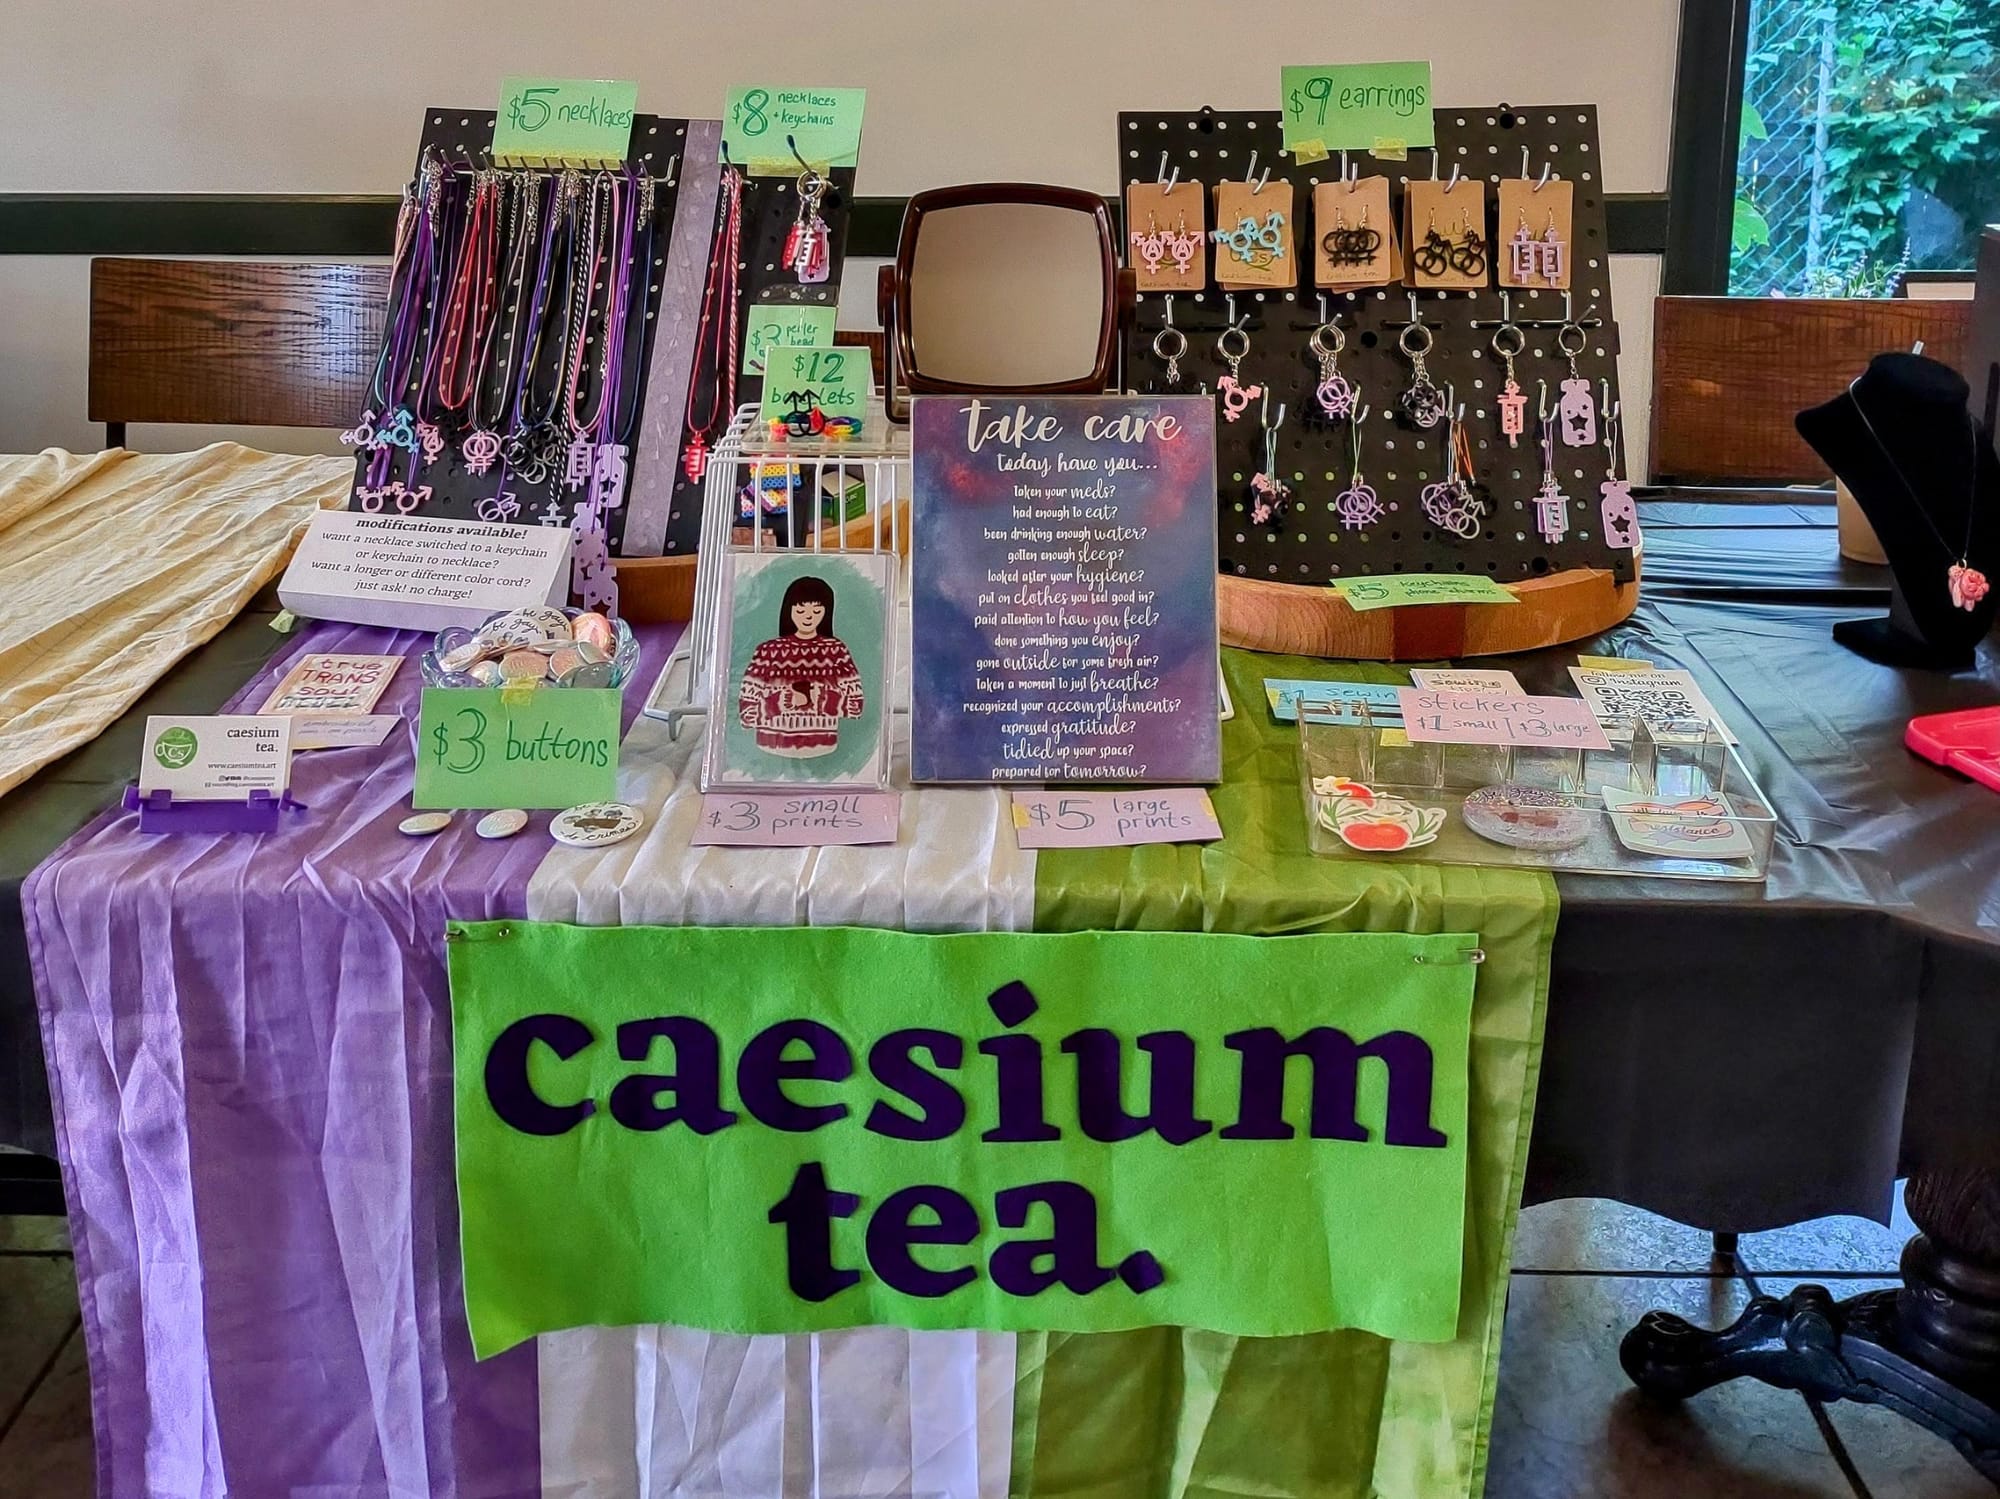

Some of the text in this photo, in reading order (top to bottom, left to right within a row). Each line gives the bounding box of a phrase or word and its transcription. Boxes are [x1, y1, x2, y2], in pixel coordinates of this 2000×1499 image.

[507, 88, 634, 131] $5 necklaces
[1290, 77, 1425, 125] $9 earrings
[731, 89, 836, 137] $8 necklaces
[786, 323, 818, 337] perler
[791, 336, 815, 346] bead
[792, 351, 845, 385] $12
[772, 387, 855, 406] blets
[959, 399, 1182, 452] take care
[997, 453, 1158, 478] today have you...
[1014, 479, 1116, 501] taken your meds?
[1013, 506, 1118, 522] had enough to eat?
[356, 518, 528, 540] modifications available!
[984, 527, 1147, 542] been drinking enough water?
[322, 531, 351, 542] want
[364, 534, 413, 548] necklace
[416, 538, 468, 553] switched
[470, 543, 482, 553] to
[485, 545, 492, 553] a
[495, 542, 548, 559] keychain
[1008, 542, 1124, 568] gotten enough sleep?
[355, 550, 499, 570] or keychain to necklace?
[312, 560, 342, 572] want
[354, 563, 392, 581] longer
[395, 568, 409, 577] or
[410, 566, 462, 583] different
[464, 573, 494, 586] color
[497, 575, 531, 588] cord?
[988, 564, 1144, 589] looked after your hygiene?
[354, 578, 473, 600] just ask! no charge!
[978, 587, 1155, 608] put on clothes you feel good in?
[1348, 582, 1389, 600] $5
[974, 607, 1159, 633] paid attention to how you feel?
[994, 633, 1140, 655] done something you enjoy?
[321, 659, 382, 670] true
[976, 651, 1159, 671] gone outside for some fresh air?
[302, 670, 380, 684] TRANS
[976, 672, 1159, 692] taken a moment to just breathe?
[298, 686, 361, 696] soul
[1326, 687, 1397, 698] sewin
[963, 693, 1181, 722] recognized your accomplishments?
[227, 727, 279, 738] caesium
[1001, 713, 1137, 744] expressed gratitude?
[1453, 719, 1500, 731] small
[1553, 722, 1591, 737] large
[256, 743, 279, 753] tea.
[433, 707, 608, 774] $3 buttons
[1003, 738, 1135, 761] tidied up your space?
[992, 763, 1147, 779] prepared for tomorrow?
[707, 796, 861, 831] $3 small
[771, 814, 863, 835] prints
[1029, 797, 1170, 831] $5 large
[1117, 813, 1192, 838] prints
[482, 978, 1449, 1148] caesium
[767, 1160, 1165, 1302] tea.
